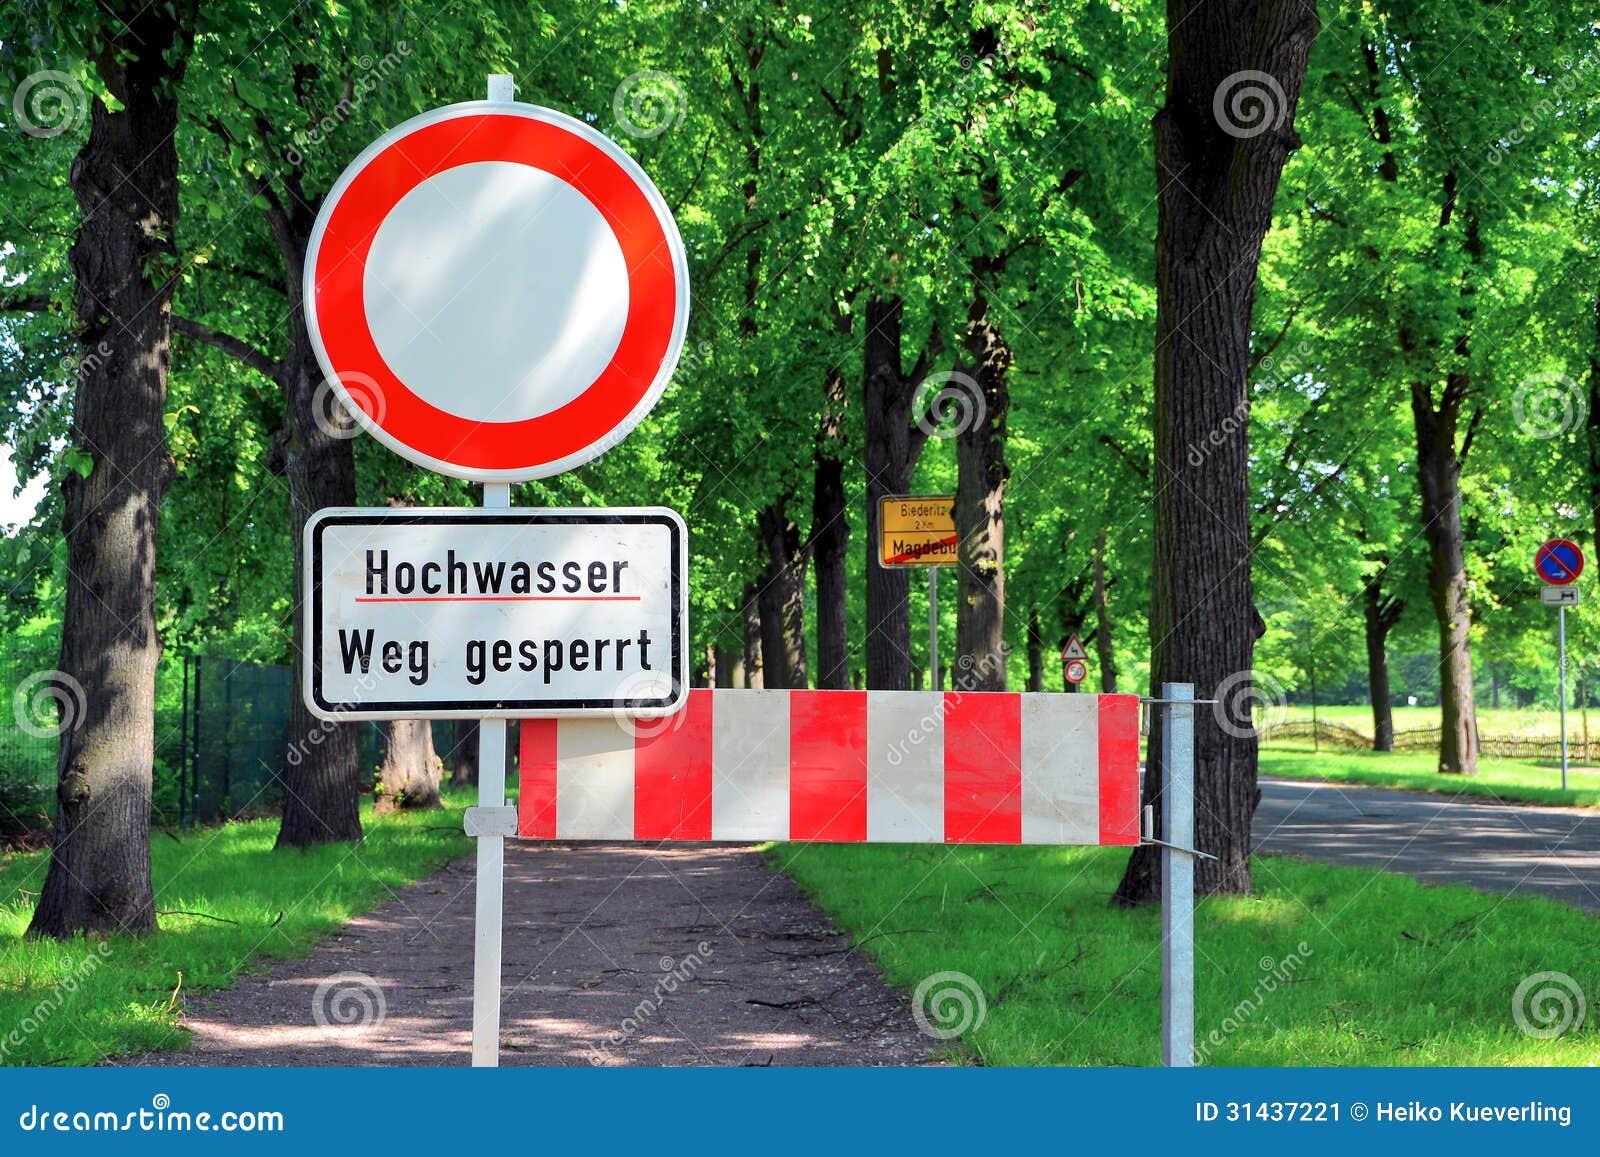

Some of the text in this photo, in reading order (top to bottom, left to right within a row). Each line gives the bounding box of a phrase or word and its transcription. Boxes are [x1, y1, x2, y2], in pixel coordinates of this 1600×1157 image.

[901, 503, 947, 517] Biederitz
[893, 538, 957, 559] Magdebu
[366, 550, 628, 594] Hochwasser
[338, 629, 652, 686] Weg gesperrt
